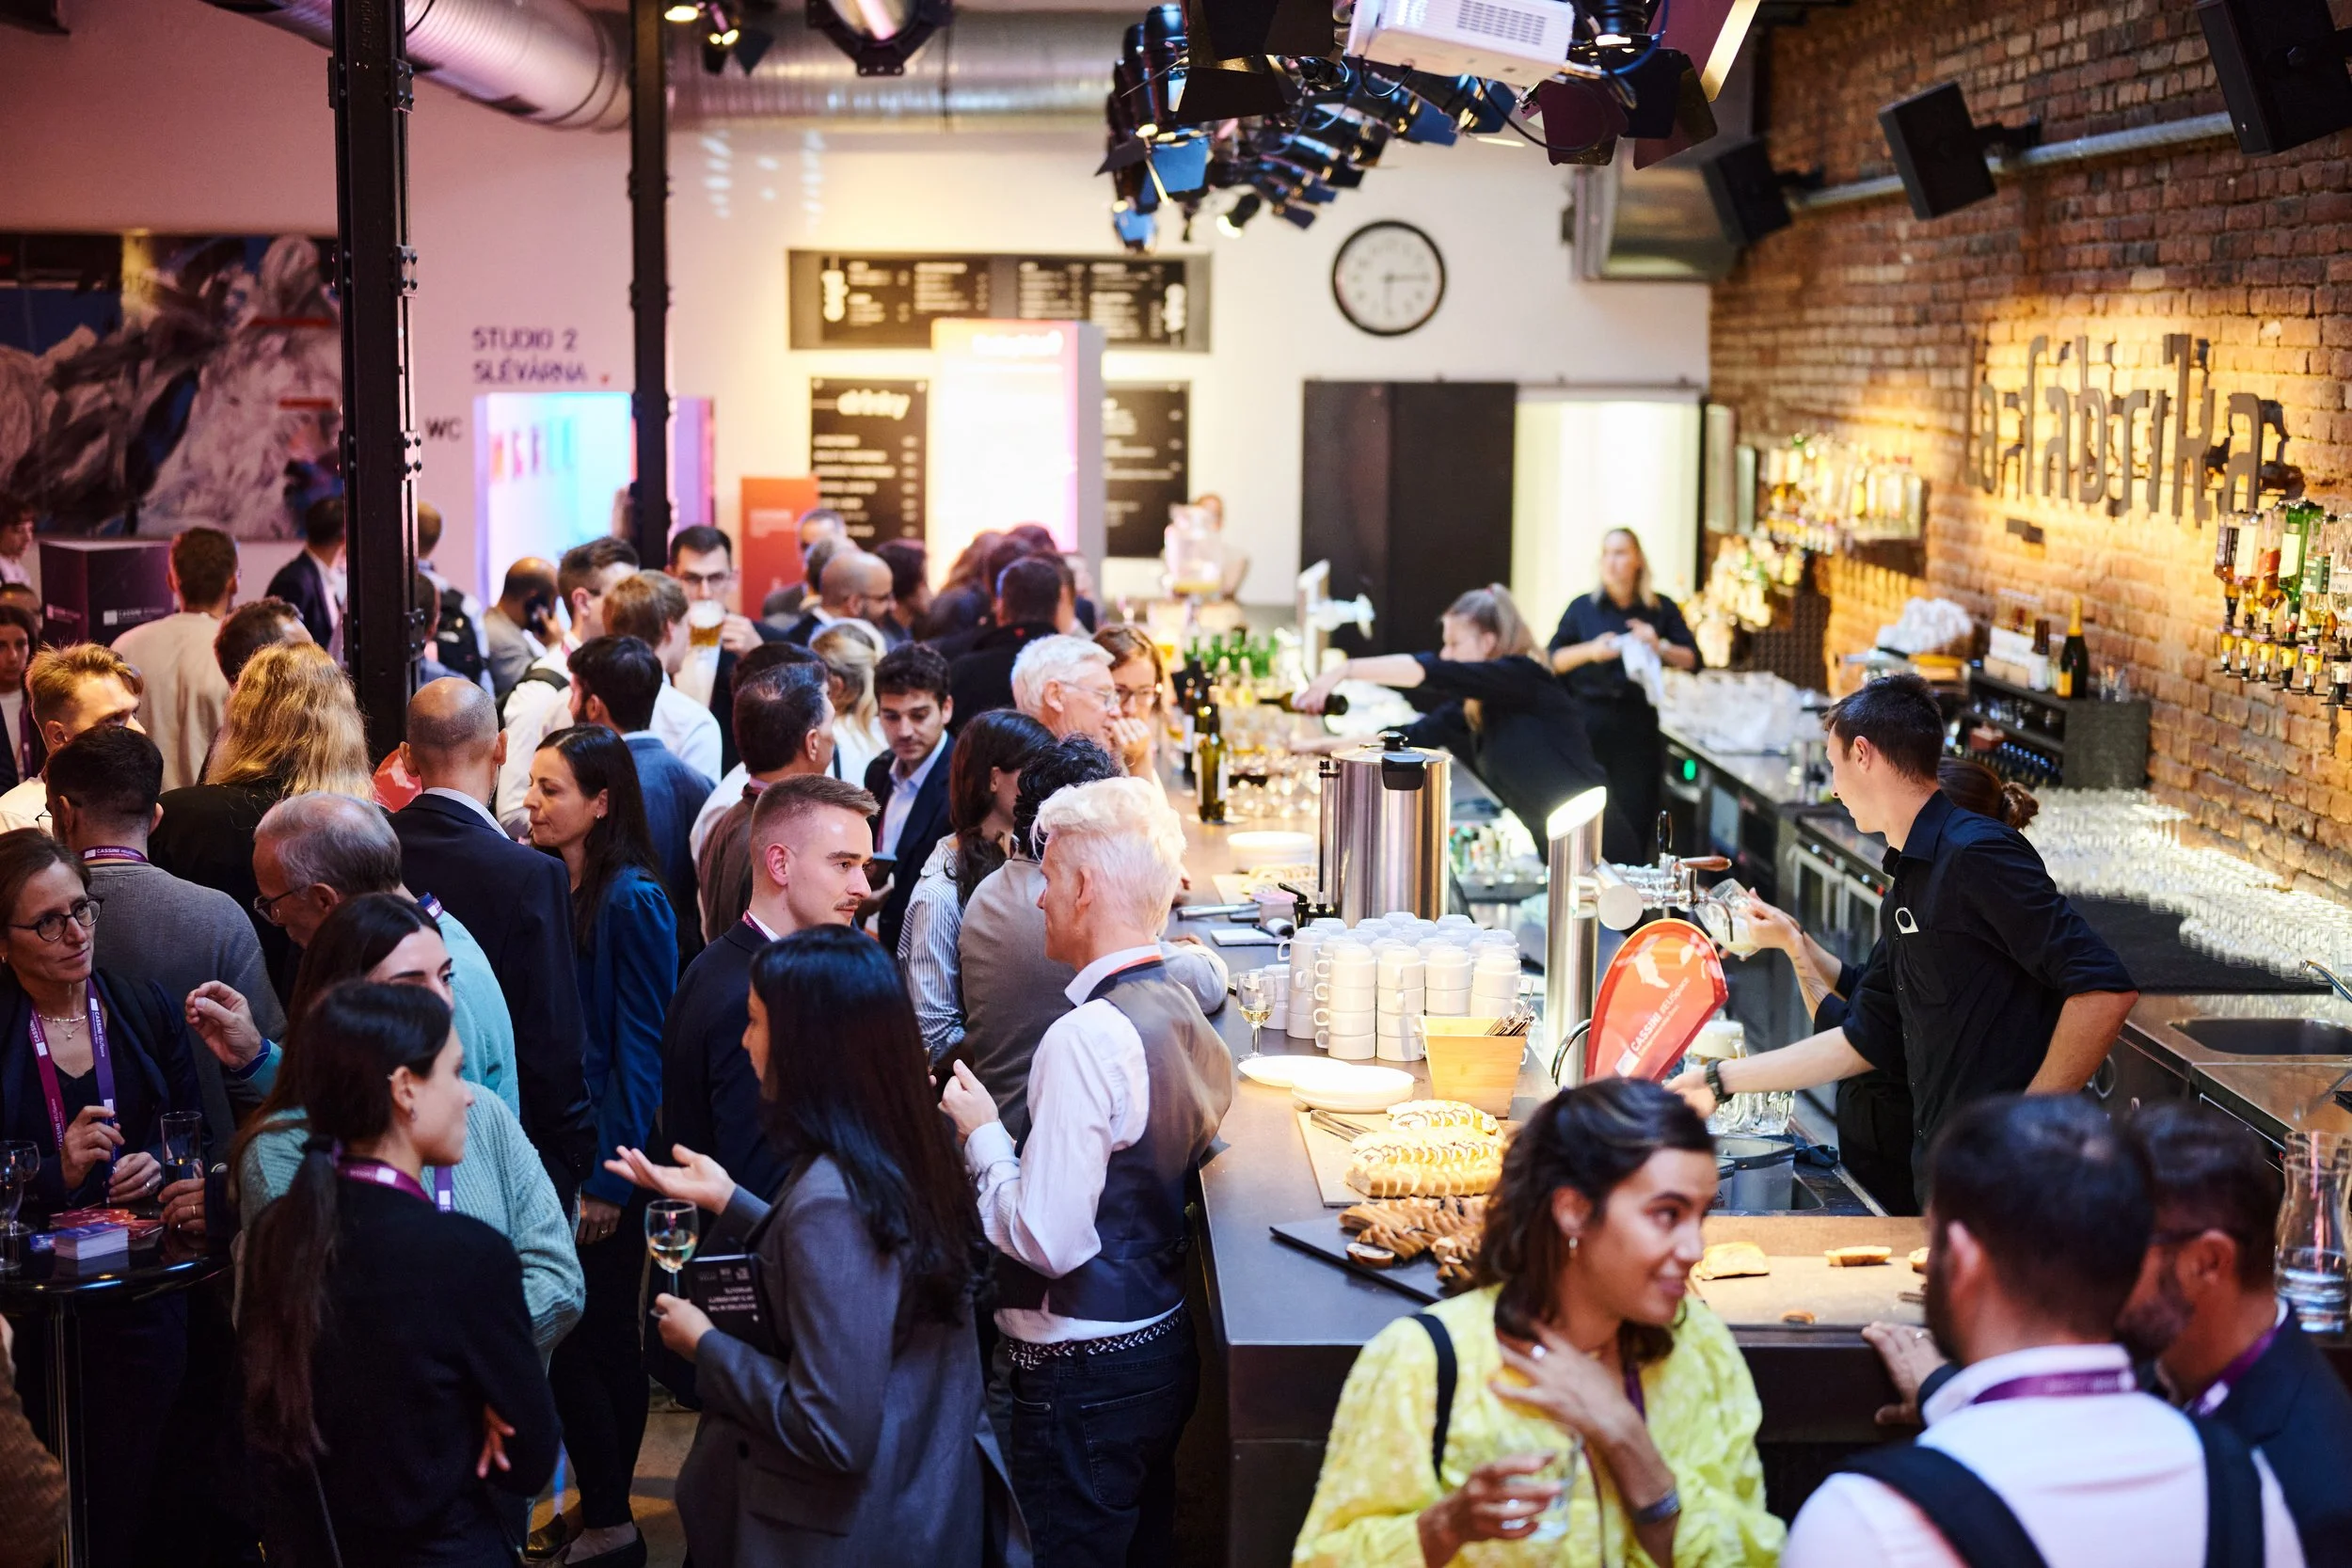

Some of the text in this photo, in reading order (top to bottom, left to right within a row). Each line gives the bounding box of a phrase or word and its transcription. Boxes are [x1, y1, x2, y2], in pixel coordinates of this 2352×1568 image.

[472, 327, 578, 352] STUDIO 2
[472, 355, 588, 384] SLÉVÁRNA
[425, 417, 463, 441] WC
[94, 1011, 103, 1035] CASSINI
[1630, 1011, 1662, 1052] CASSINI
[1660, 976, 1691, 1014] #EUSpace
